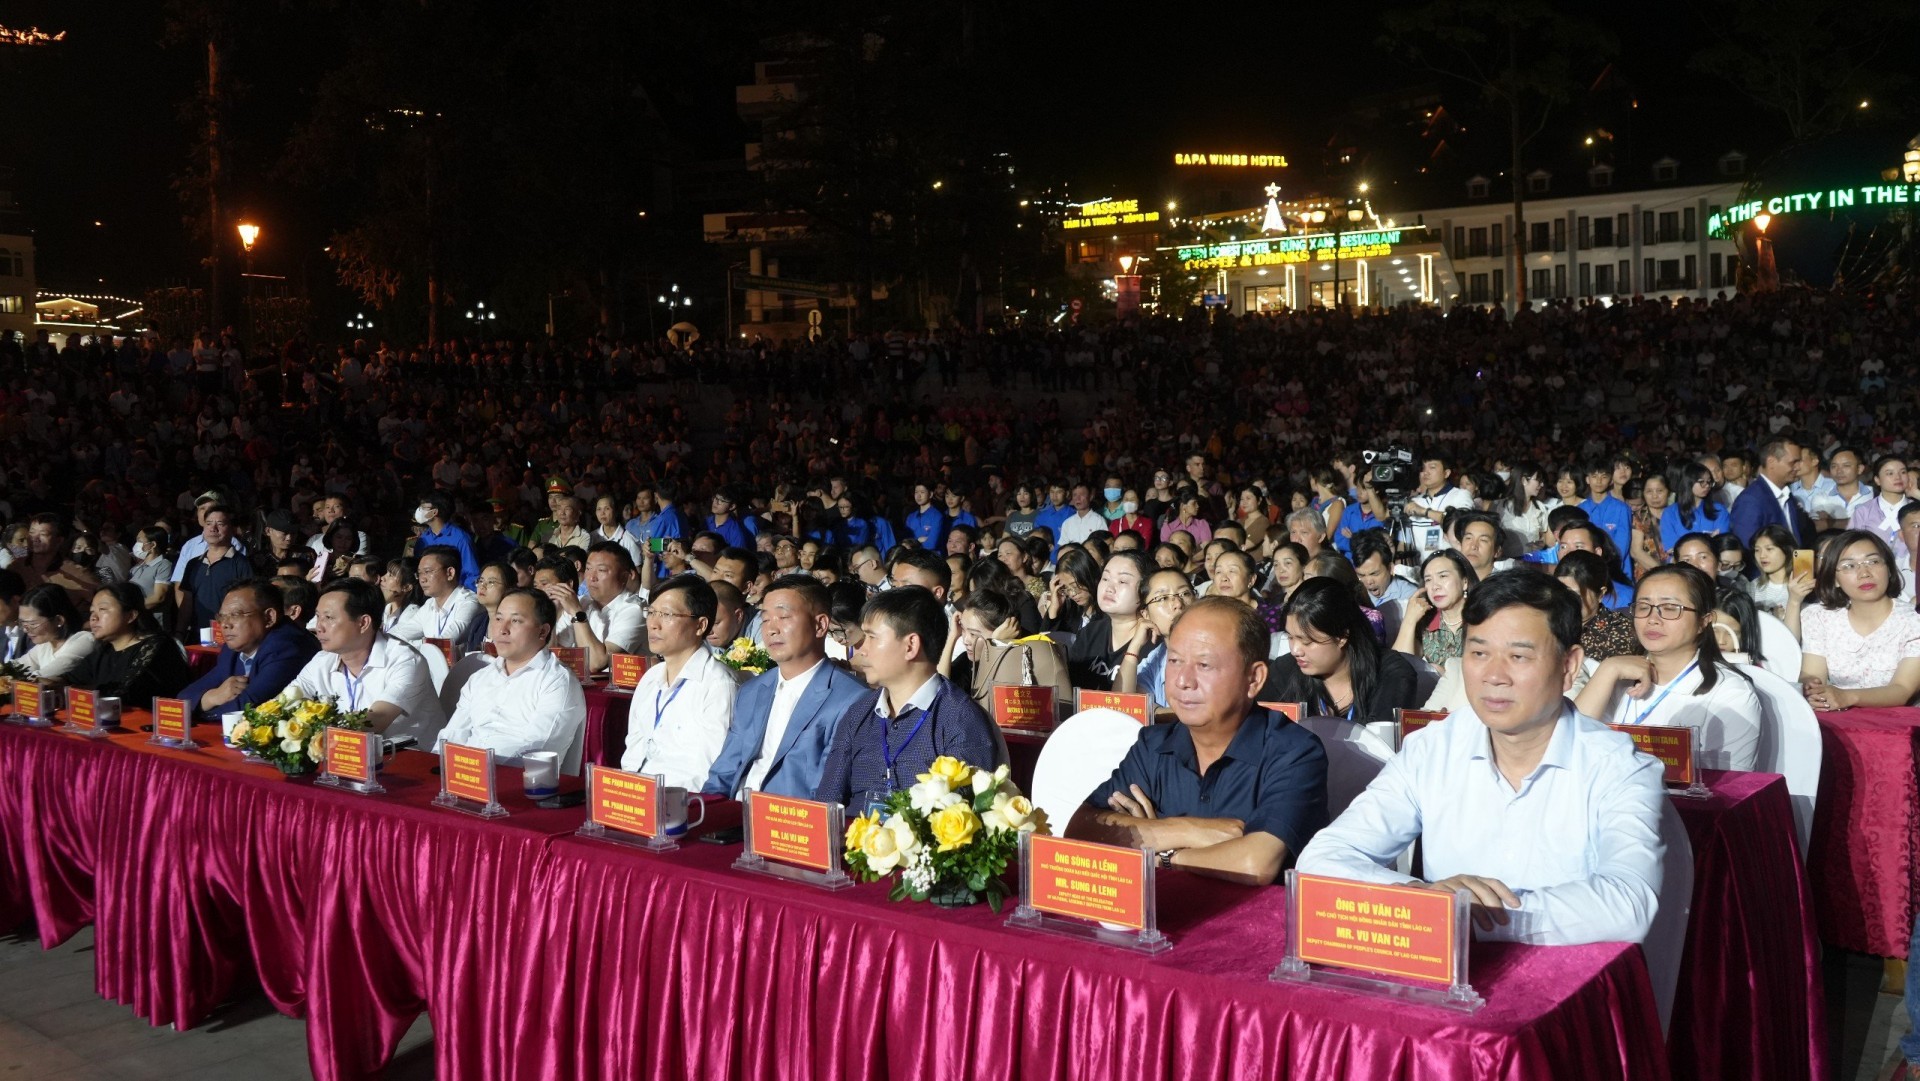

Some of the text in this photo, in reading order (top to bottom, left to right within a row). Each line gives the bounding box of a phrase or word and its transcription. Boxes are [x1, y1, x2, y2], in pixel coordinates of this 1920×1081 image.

[1175, 153, 1288, 167] SAPA WINGS HOTEL
[1082, 199, 1138, 216] MASSAGE
[1728, 200, 1763, 223] THE
[1768, 191, 1823, 215] CITY
[1829, 188, 1855, 208] IN
[1861, 184, 1909, 204] THE
[1209, 244, 1241, 257] FOREST
[1243, 241, 1271, 255] HOTEL
[1341, 230, 1401, 247] RESTAURANT
[1240, 253, 1252, 266] &
[1255, 249, 1310, 266] DRINKS
[1054, 851, 1070, 865] ÔNG
[1091, 858, 1098, 870] A
[1055, 877, 1118, 898] MR. SUNG A LENH
[1336, 897, 1356, 912] ÔNG
[1372, 903, 1392, 918] VĂN
[1394, 905, 1411, 920] CÀI
[1336, 926, 1410, 948] MR. VU VAN CAI
